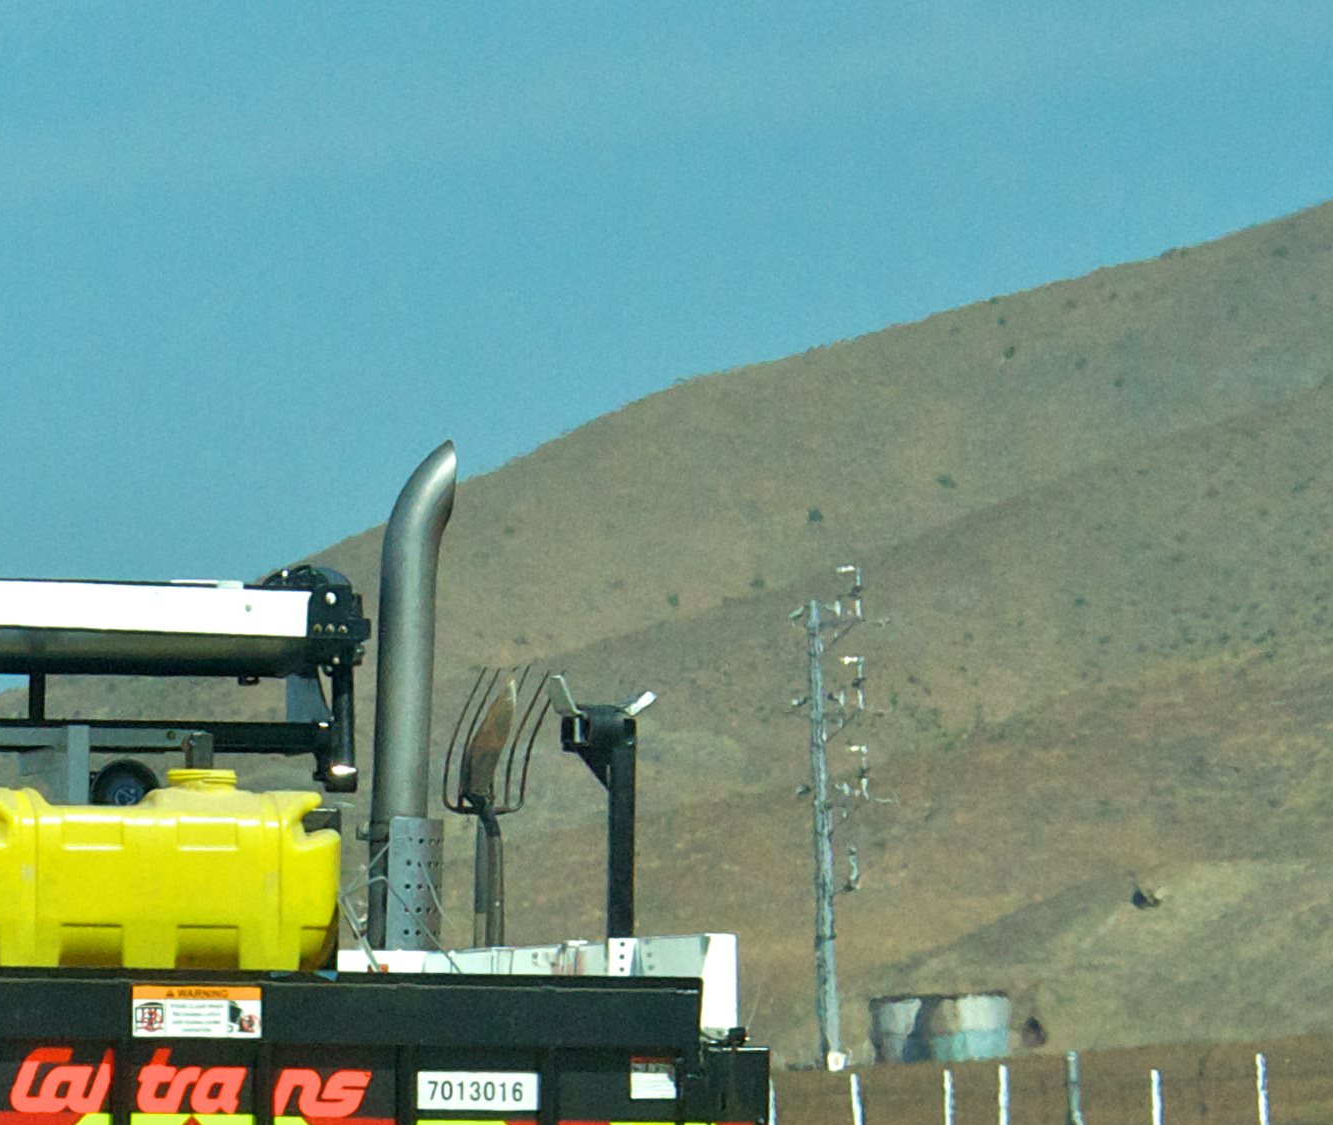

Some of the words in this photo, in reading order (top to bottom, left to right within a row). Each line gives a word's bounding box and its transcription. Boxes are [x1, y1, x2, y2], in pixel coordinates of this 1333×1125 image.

[177, 989, 229, 999] WARNING
[10, 1046, 372, 1118] Caltrans
[427, 1079, 524, 1103] 7013016
